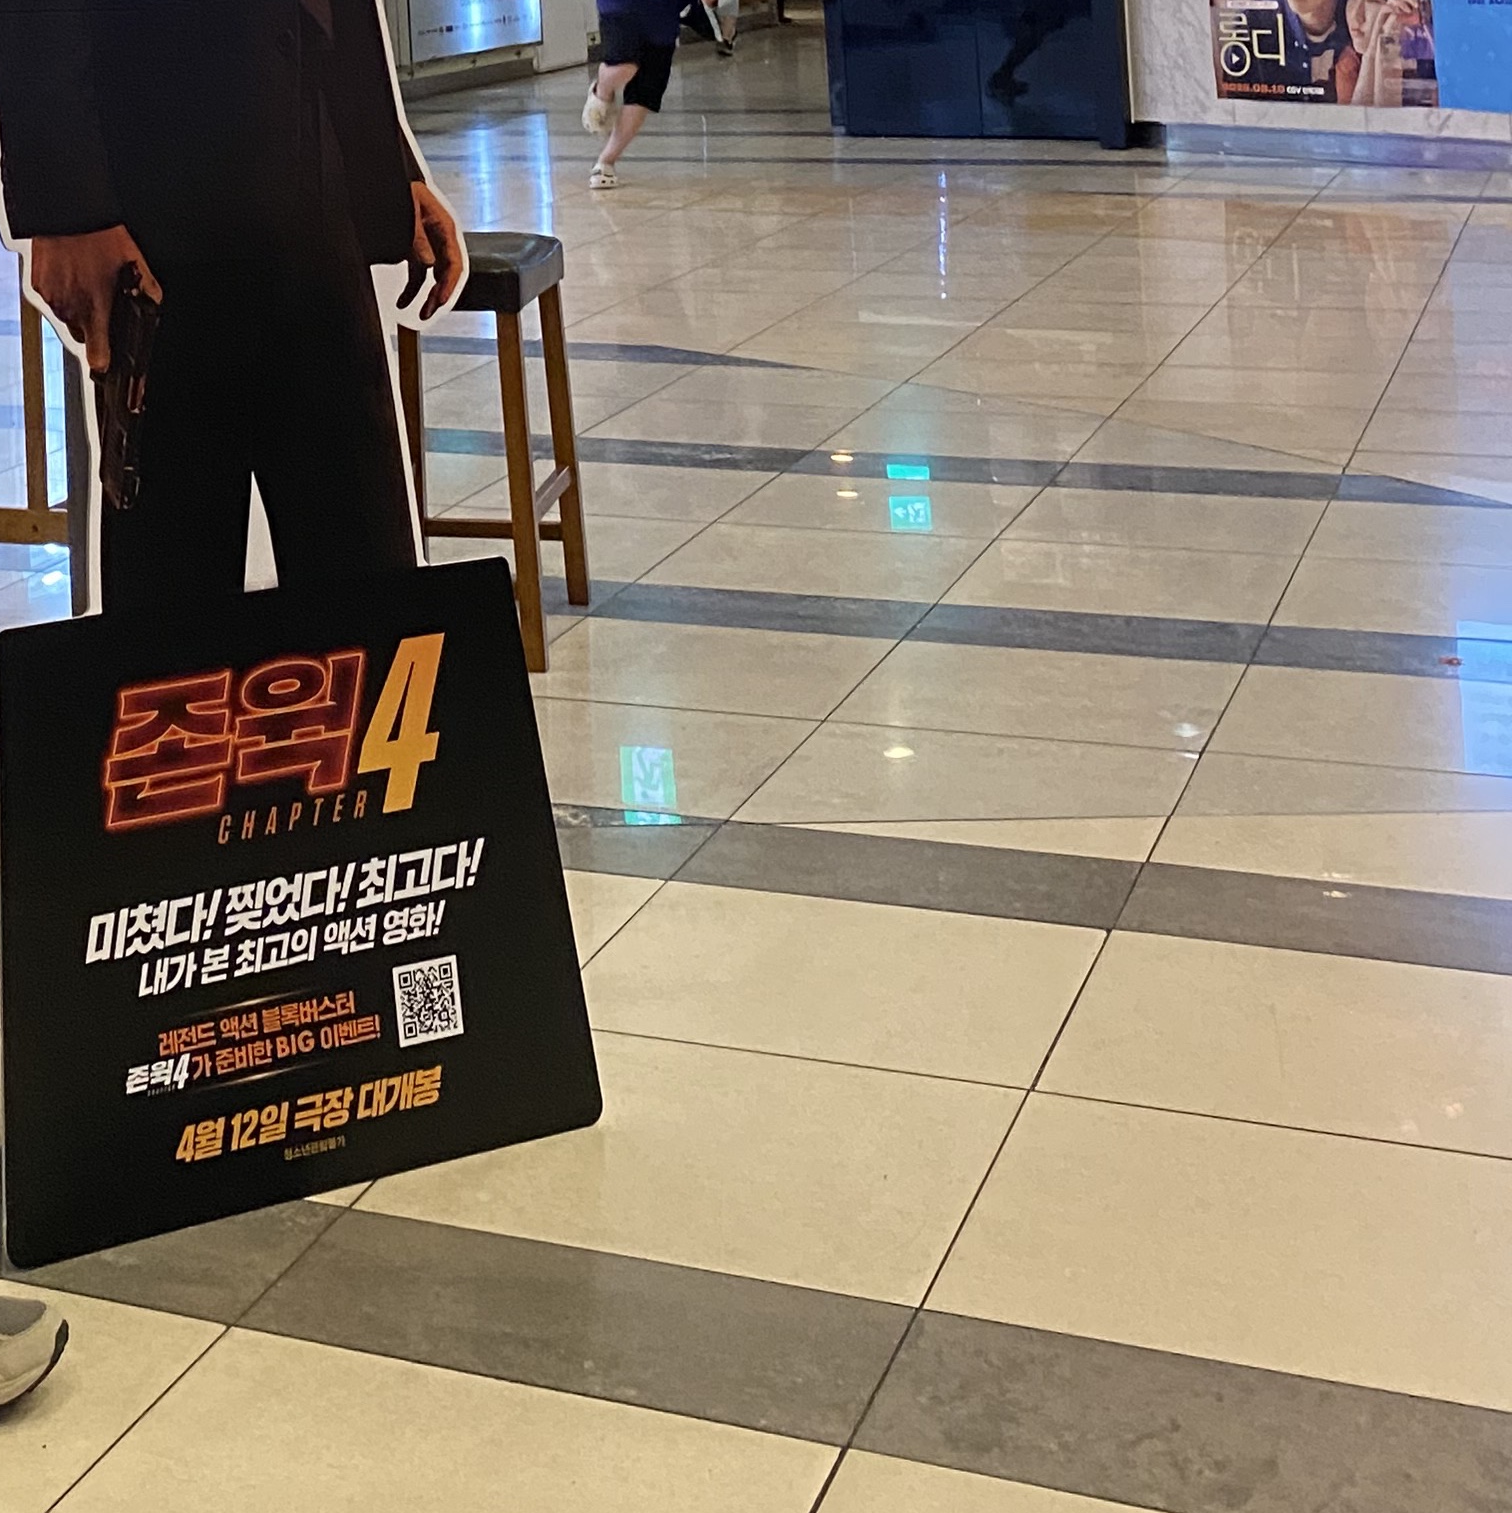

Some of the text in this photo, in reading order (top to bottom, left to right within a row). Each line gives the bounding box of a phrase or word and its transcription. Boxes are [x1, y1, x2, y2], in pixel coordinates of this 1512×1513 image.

[1218, 13, 1286, 77] 롱디
[104, 632, 445, 830] 존윅 4
[217, 790, 368, 845] CHAPTER
[85, 838, 485, 964] 미쳤다! 찢었다! 최고다!
[138, 900, 446, 997] 내가 본 최고의 액션 영화!
[158, 990, 355, 1058] 레전드 액션 블록버스터
[215, 1038, 273, 1076] 준비한
[276, 1030, 315, 1060] BIG
[320, 1014, 381, 1049] 이벤트!
[175, 1064, 443, 1163] 4월 12일 극장 대개봉
